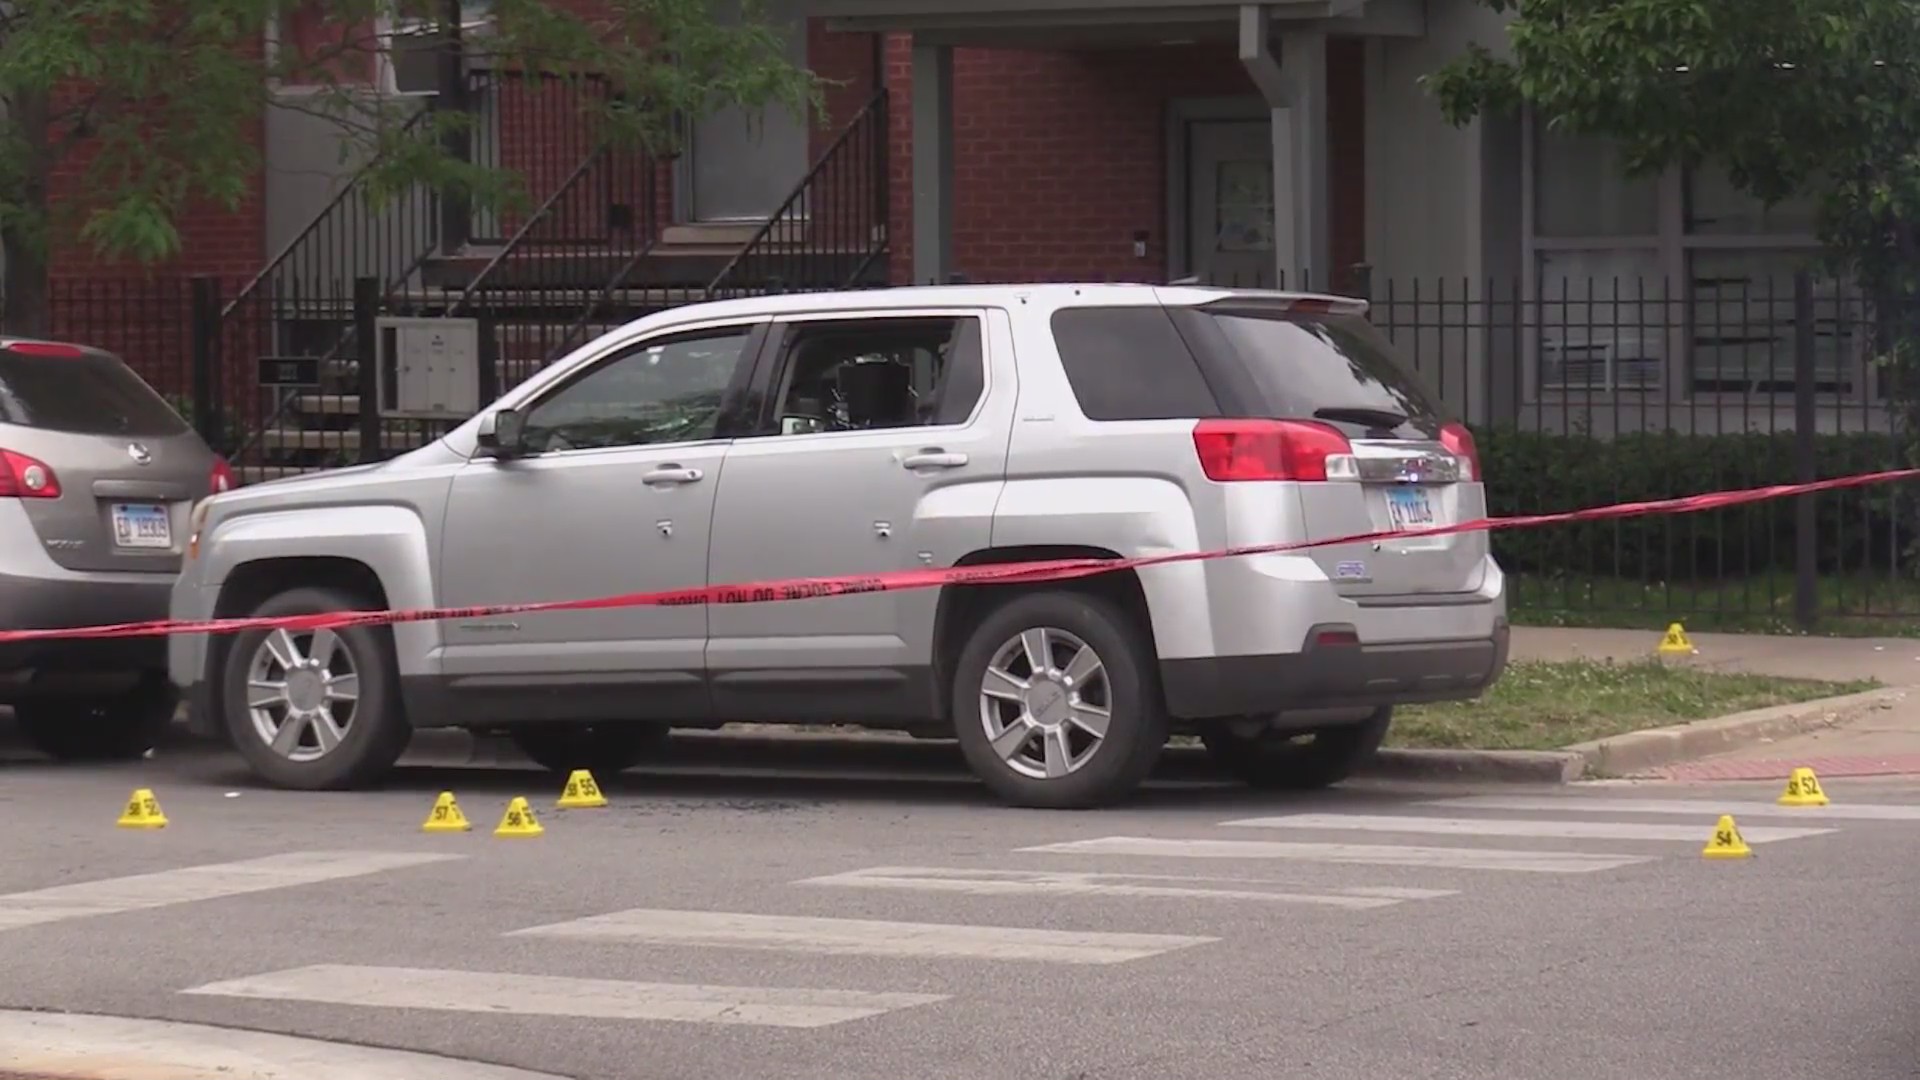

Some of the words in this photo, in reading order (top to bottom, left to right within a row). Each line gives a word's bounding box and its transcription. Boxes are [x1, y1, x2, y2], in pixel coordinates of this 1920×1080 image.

[1801, 776, 1819, 795] 52
[434, 806, 448, 820] 57
[1716, 830, 1732, 847] 54
